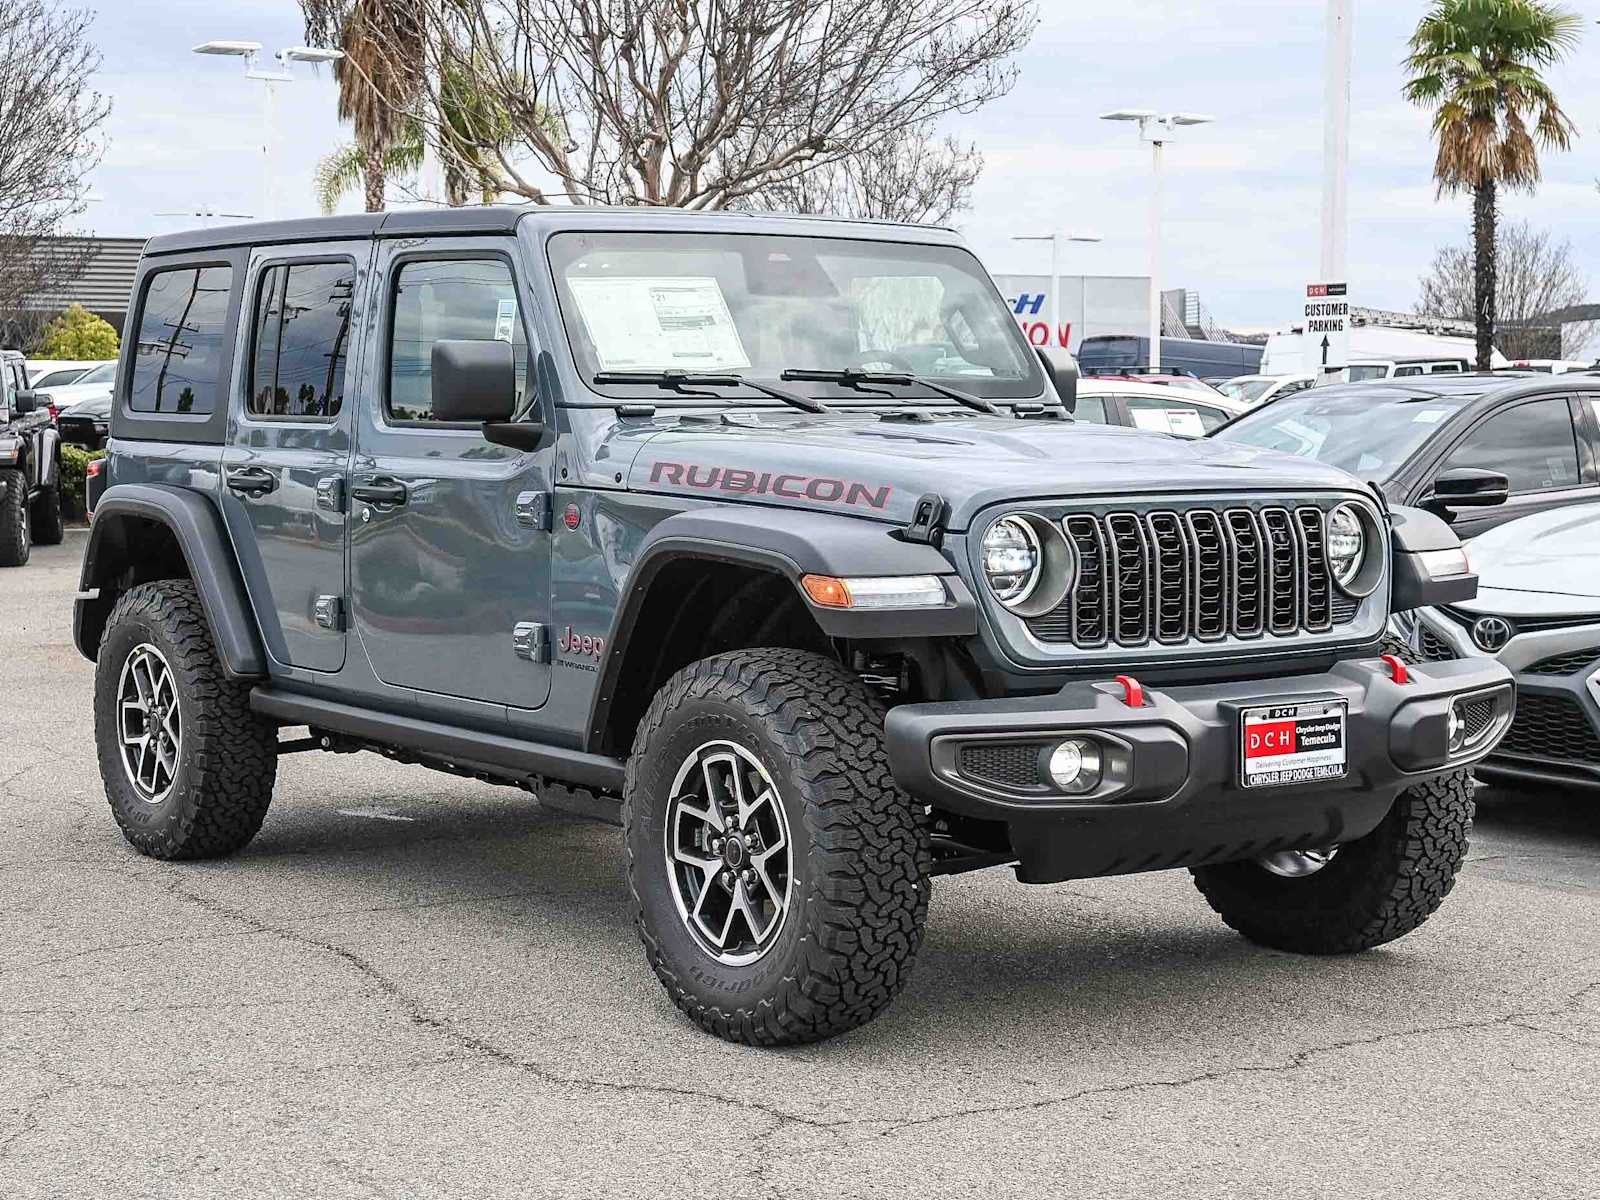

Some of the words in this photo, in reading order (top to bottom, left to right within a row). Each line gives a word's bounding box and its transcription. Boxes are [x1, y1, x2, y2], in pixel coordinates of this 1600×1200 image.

[1007, 293, 1045, 314] H
[1304, 303, 1349, 317] CUSTOMER
[1308, 319, 1344, 332] PARKING
[649, 461, 893, 510] RUBICON
[556, 624, 608, 663] Jeep
[1295, 725, 1315, 735] Chrysler
[1325, 722, 1341, 731] Dodge
[1250, 730, 1290, 749] DCH
[1300, 733, 1336, 746] Temecula
[1255, 760, 1281, 769] Delivering
[1249, 771, 1280, 785] CHRYSLER
[1280, 770, 1293, 782] JEEP
[1293, 767, 1314, 780] DODGE
[1314, 764, 1344, 777] TEMECULA
